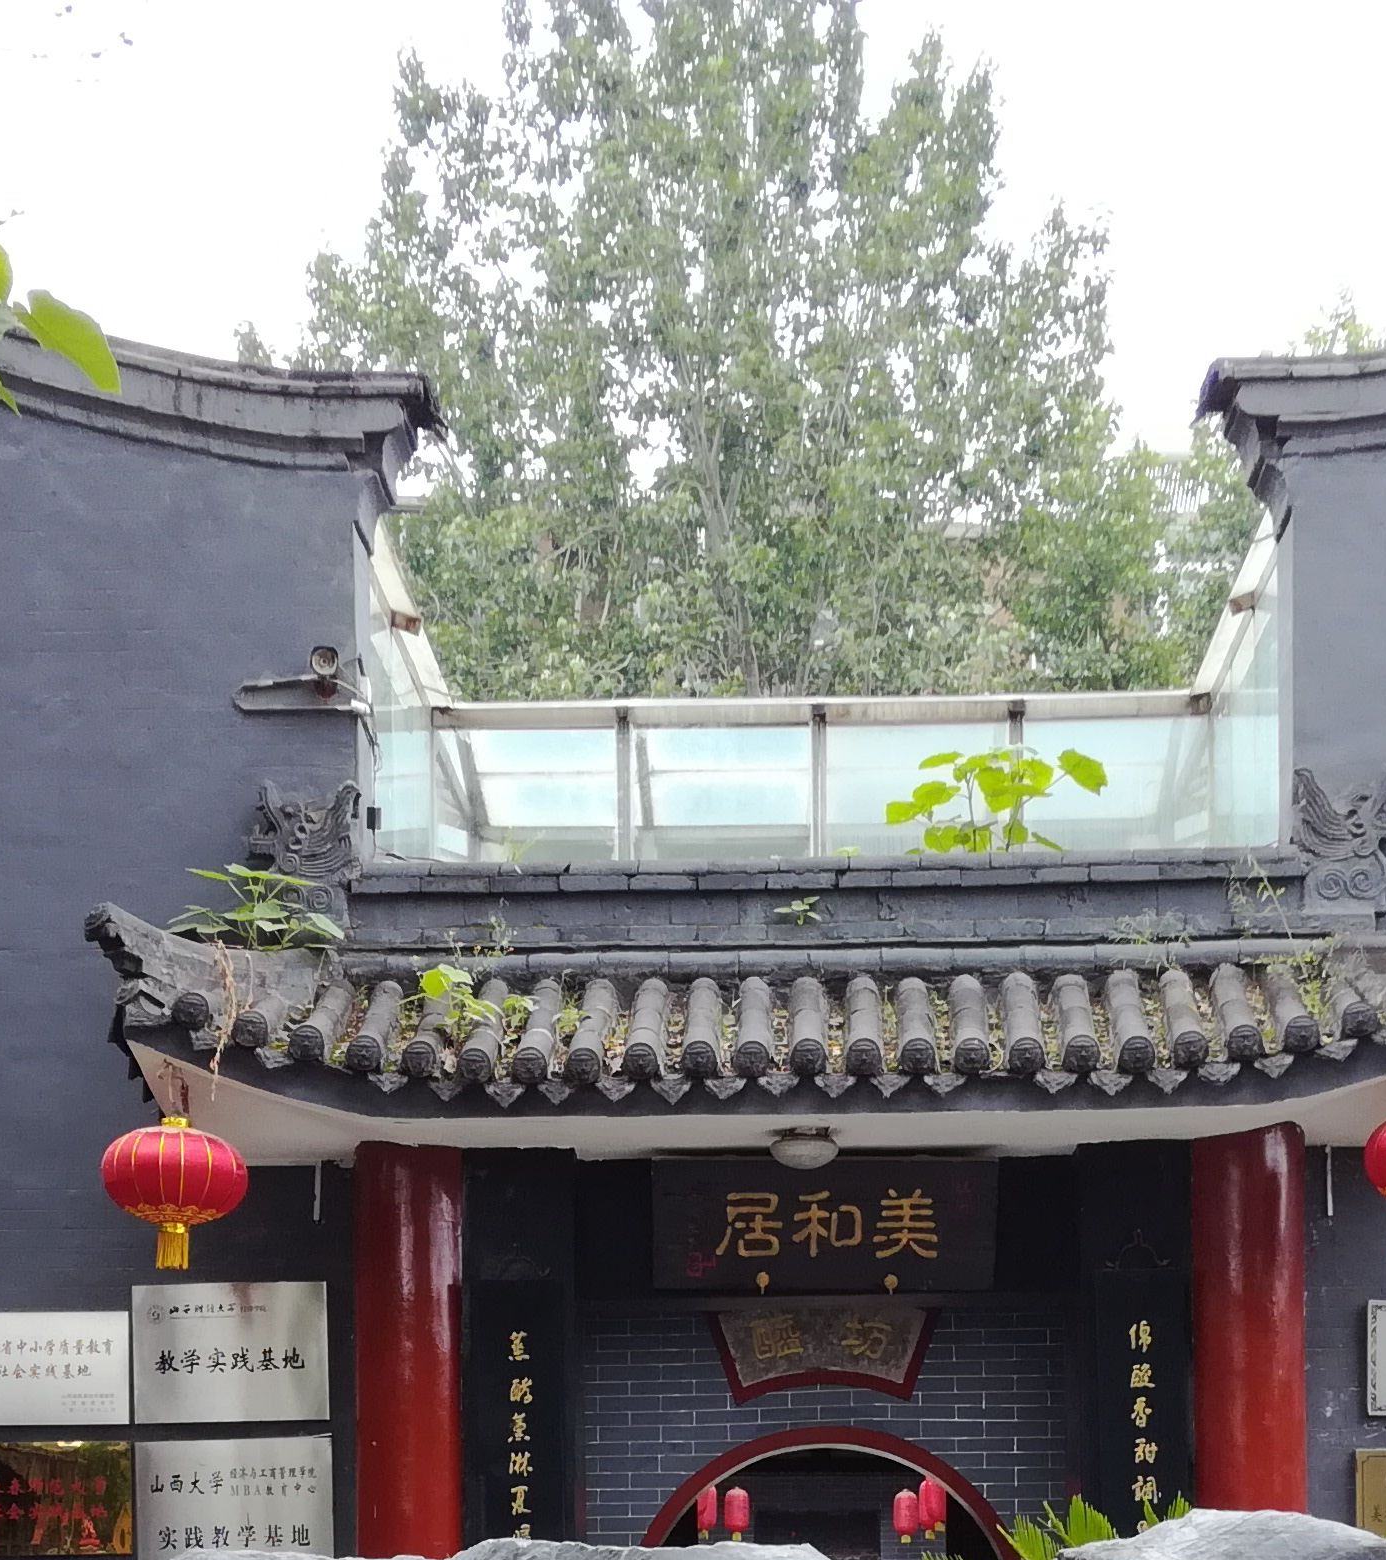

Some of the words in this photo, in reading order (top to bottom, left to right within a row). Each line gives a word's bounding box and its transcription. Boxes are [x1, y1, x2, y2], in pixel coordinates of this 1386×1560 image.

[154, 1346, 306, 1375] 教学实践基地
[149, 1471, 225, 1496] 山西大学
[158, 1523, 311, 1550] 实践教学基地
